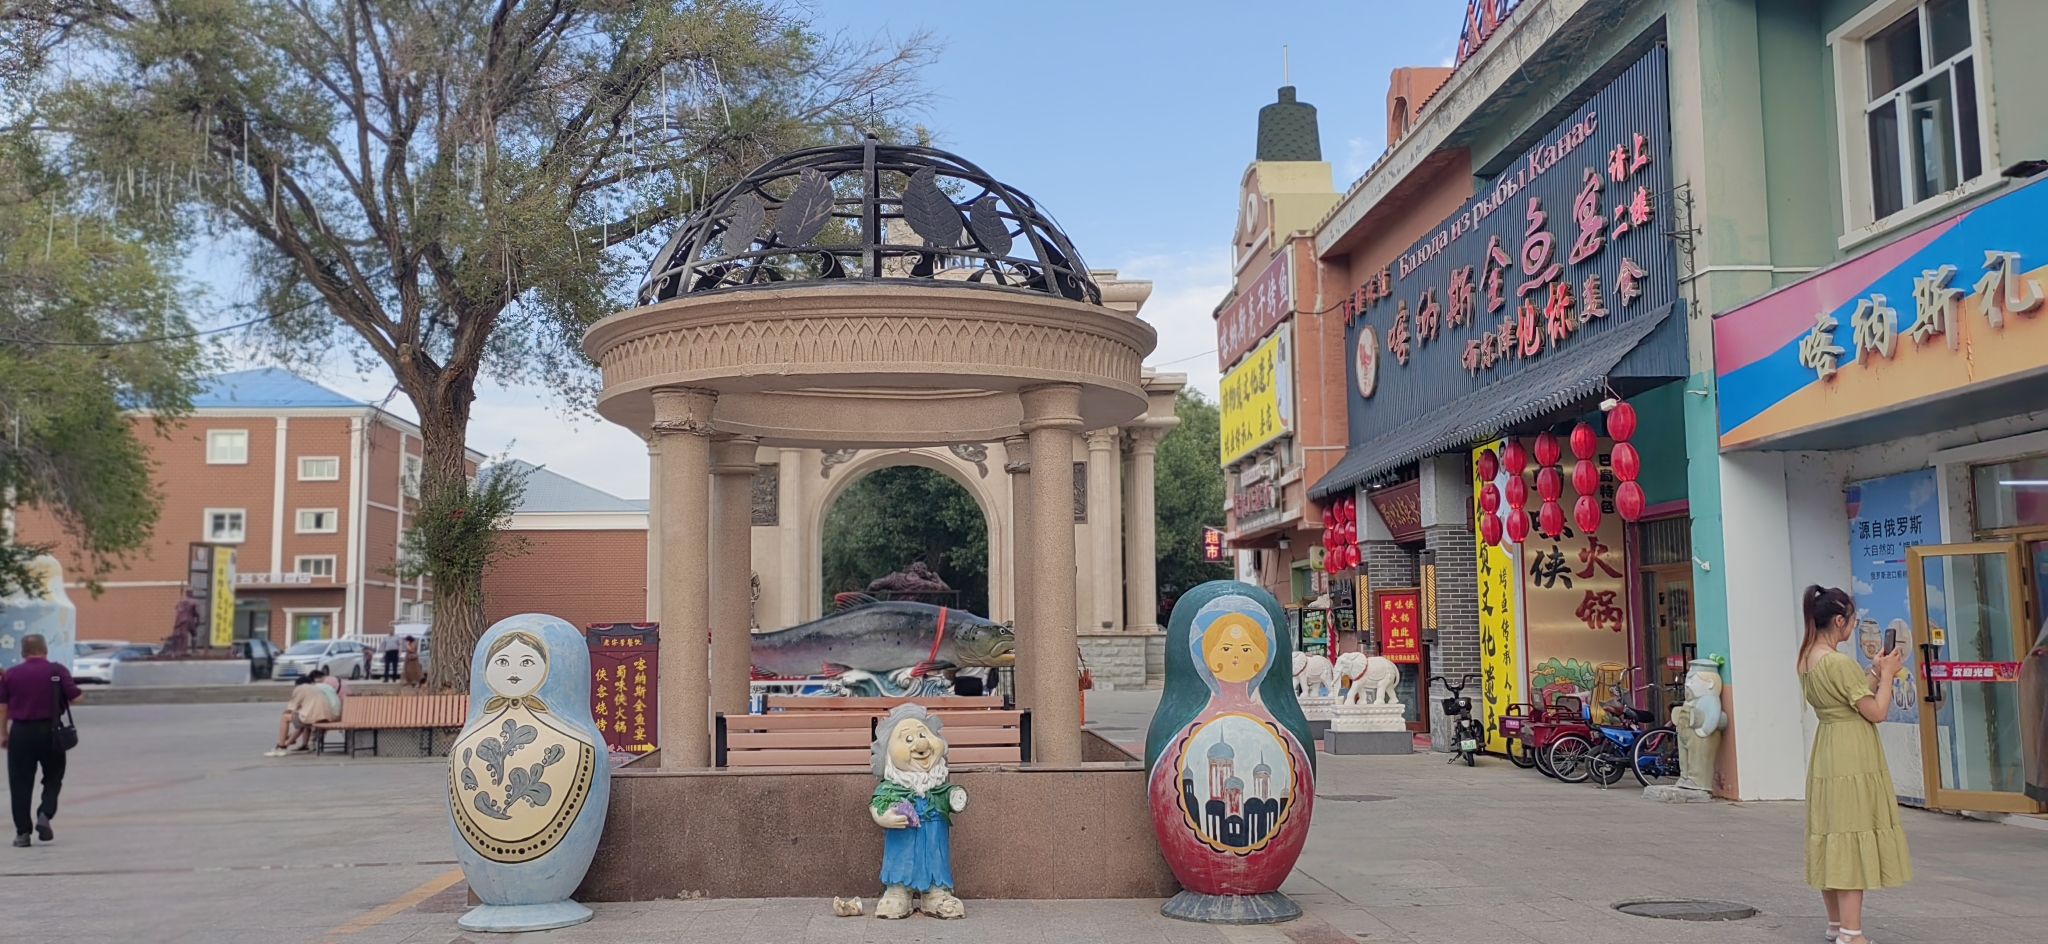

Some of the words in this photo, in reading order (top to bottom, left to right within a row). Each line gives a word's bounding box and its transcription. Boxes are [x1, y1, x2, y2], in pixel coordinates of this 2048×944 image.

[1608, 132, 1652, 183] 请上
[1398, 226, 1448, 280] Блюда
[1450, 214, 1472, 242] из
[1471, 167, 1528, 231] рыбы
[1527, 111, 1599, 182] Канас
[1611, 186, 1655, 241] 二楼
[1387, 167, 1609, 366] 喀纳斯全鱼宴
[1799, 250, 2045, 382] 喀纳斯礼
[1598, 453, 1615, 514] 巴蜀特色
[1205, 530, 1219, 559] 超市
[1858, 514, 1922, 540] 源自俄罗斯
[1575, 536, 1624, 633] 火锅
[1386, 638, 1415, 649] 上二楼
[1390, 613, 1410, 623] 火锅
[1391, 627, 1410, 637] 由此
[1498, 568, 1513, 692] 烤鱼传承人
[595, 668, 609, 733] 侠客烧烤
[614, 664, 628, 734] 蜀味侠火锅
[633, 657, 647, 741] 喀纳斯全鱼宴
[1952, 666, 1994, 678] 欢迎光临
